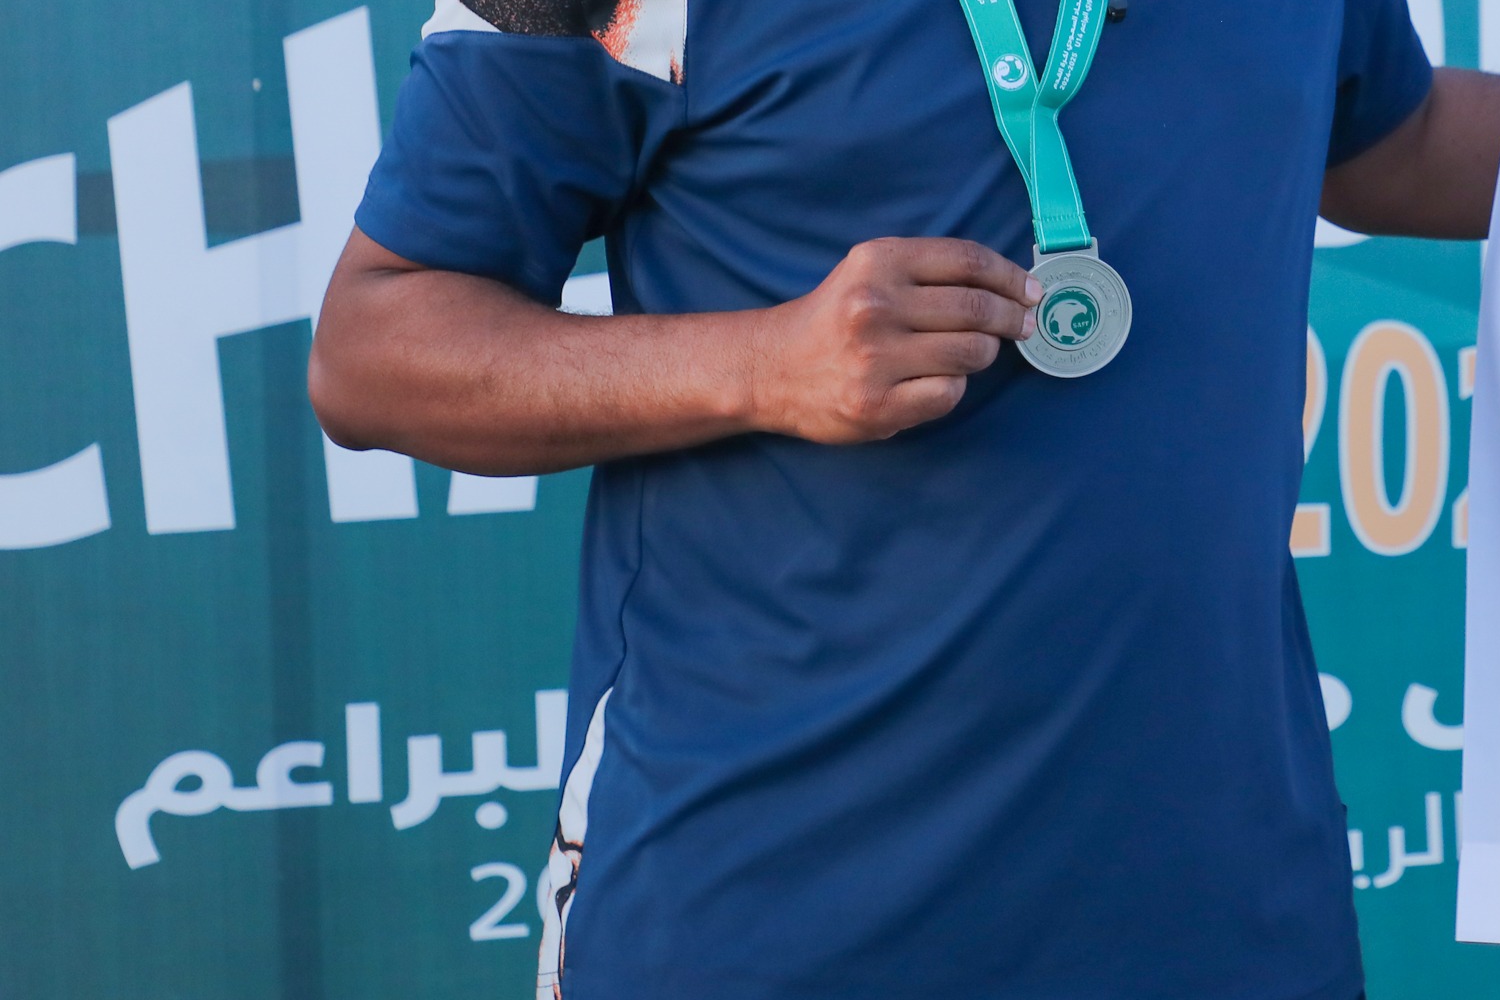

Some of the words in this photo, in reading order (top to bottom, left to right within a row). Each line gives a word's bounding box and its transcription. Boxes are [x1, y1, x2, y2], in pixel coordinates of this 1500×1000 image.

[1074, 33, 1083, 48] U14
[1060, 52, 1078, 90] 2024-2025
[115, 688, 568, 870] لبراعم
